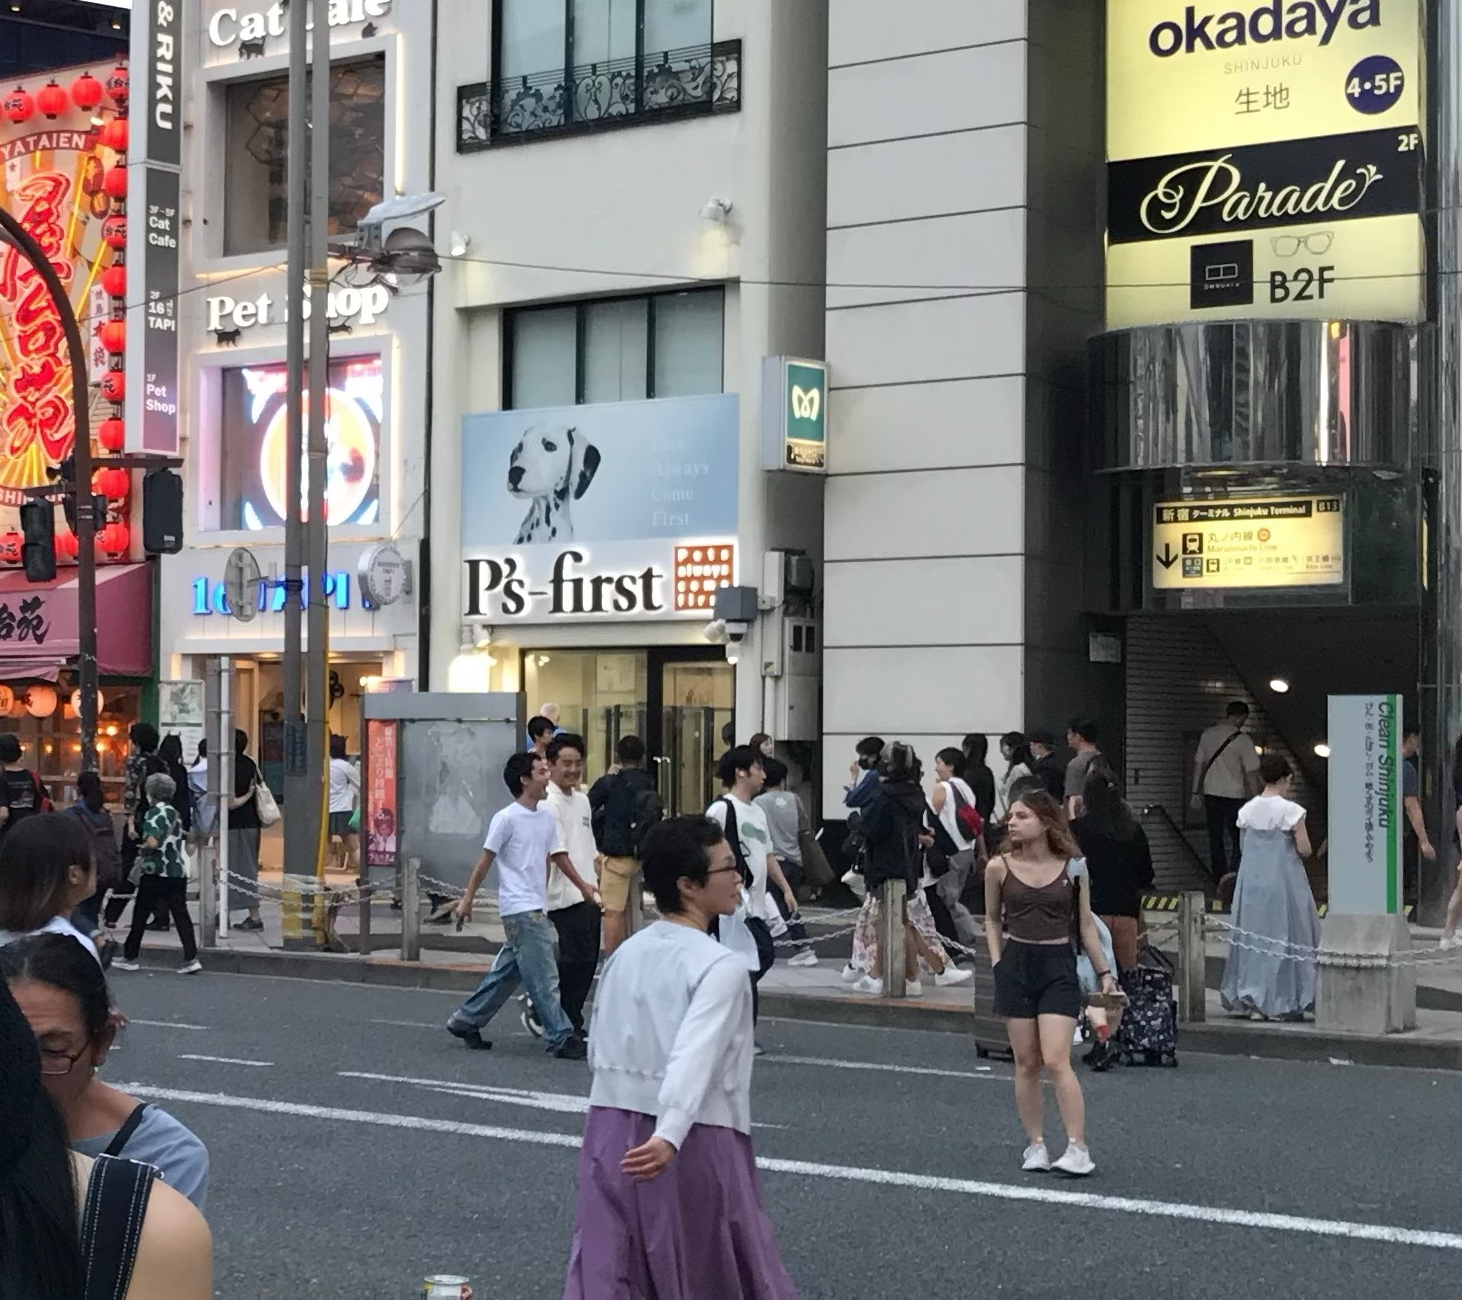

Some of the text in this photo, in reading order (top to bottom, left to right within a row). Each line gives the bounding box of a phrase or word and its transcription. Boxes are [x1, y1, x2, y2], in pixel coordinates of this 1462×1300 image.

[209, 1, 285, 47] Cat
[1223, 53, 1303, 75] SHINJUKU
[1234, 81, 1291, 115] 生地
[2, 133, 87, 160] YATAIEN
[1397, 133, 1420, 153] 2F
[1139, 154, 1383, 235] Parade
[149, 216, 171, 232] Cat
[148, 232, 177, 249] Cafe
[1269, 265, 1335, 304] B2F
[206, 291, 272, 331] Pet
[148, 316, 176, 332] TAPI
[146, 384, 168, 398] Pet
[145, 398, 177, 415] Shop
[1162, 504, 1306, 522] 新宿 ターミナル Shinjuku Terminal
[1207, 530, 1254, 544] 丸ノ内線
[1207, 542, 1278, 554] Marunouchi Line
[1375, 701, 1395, 829] Clean Shinjuku
